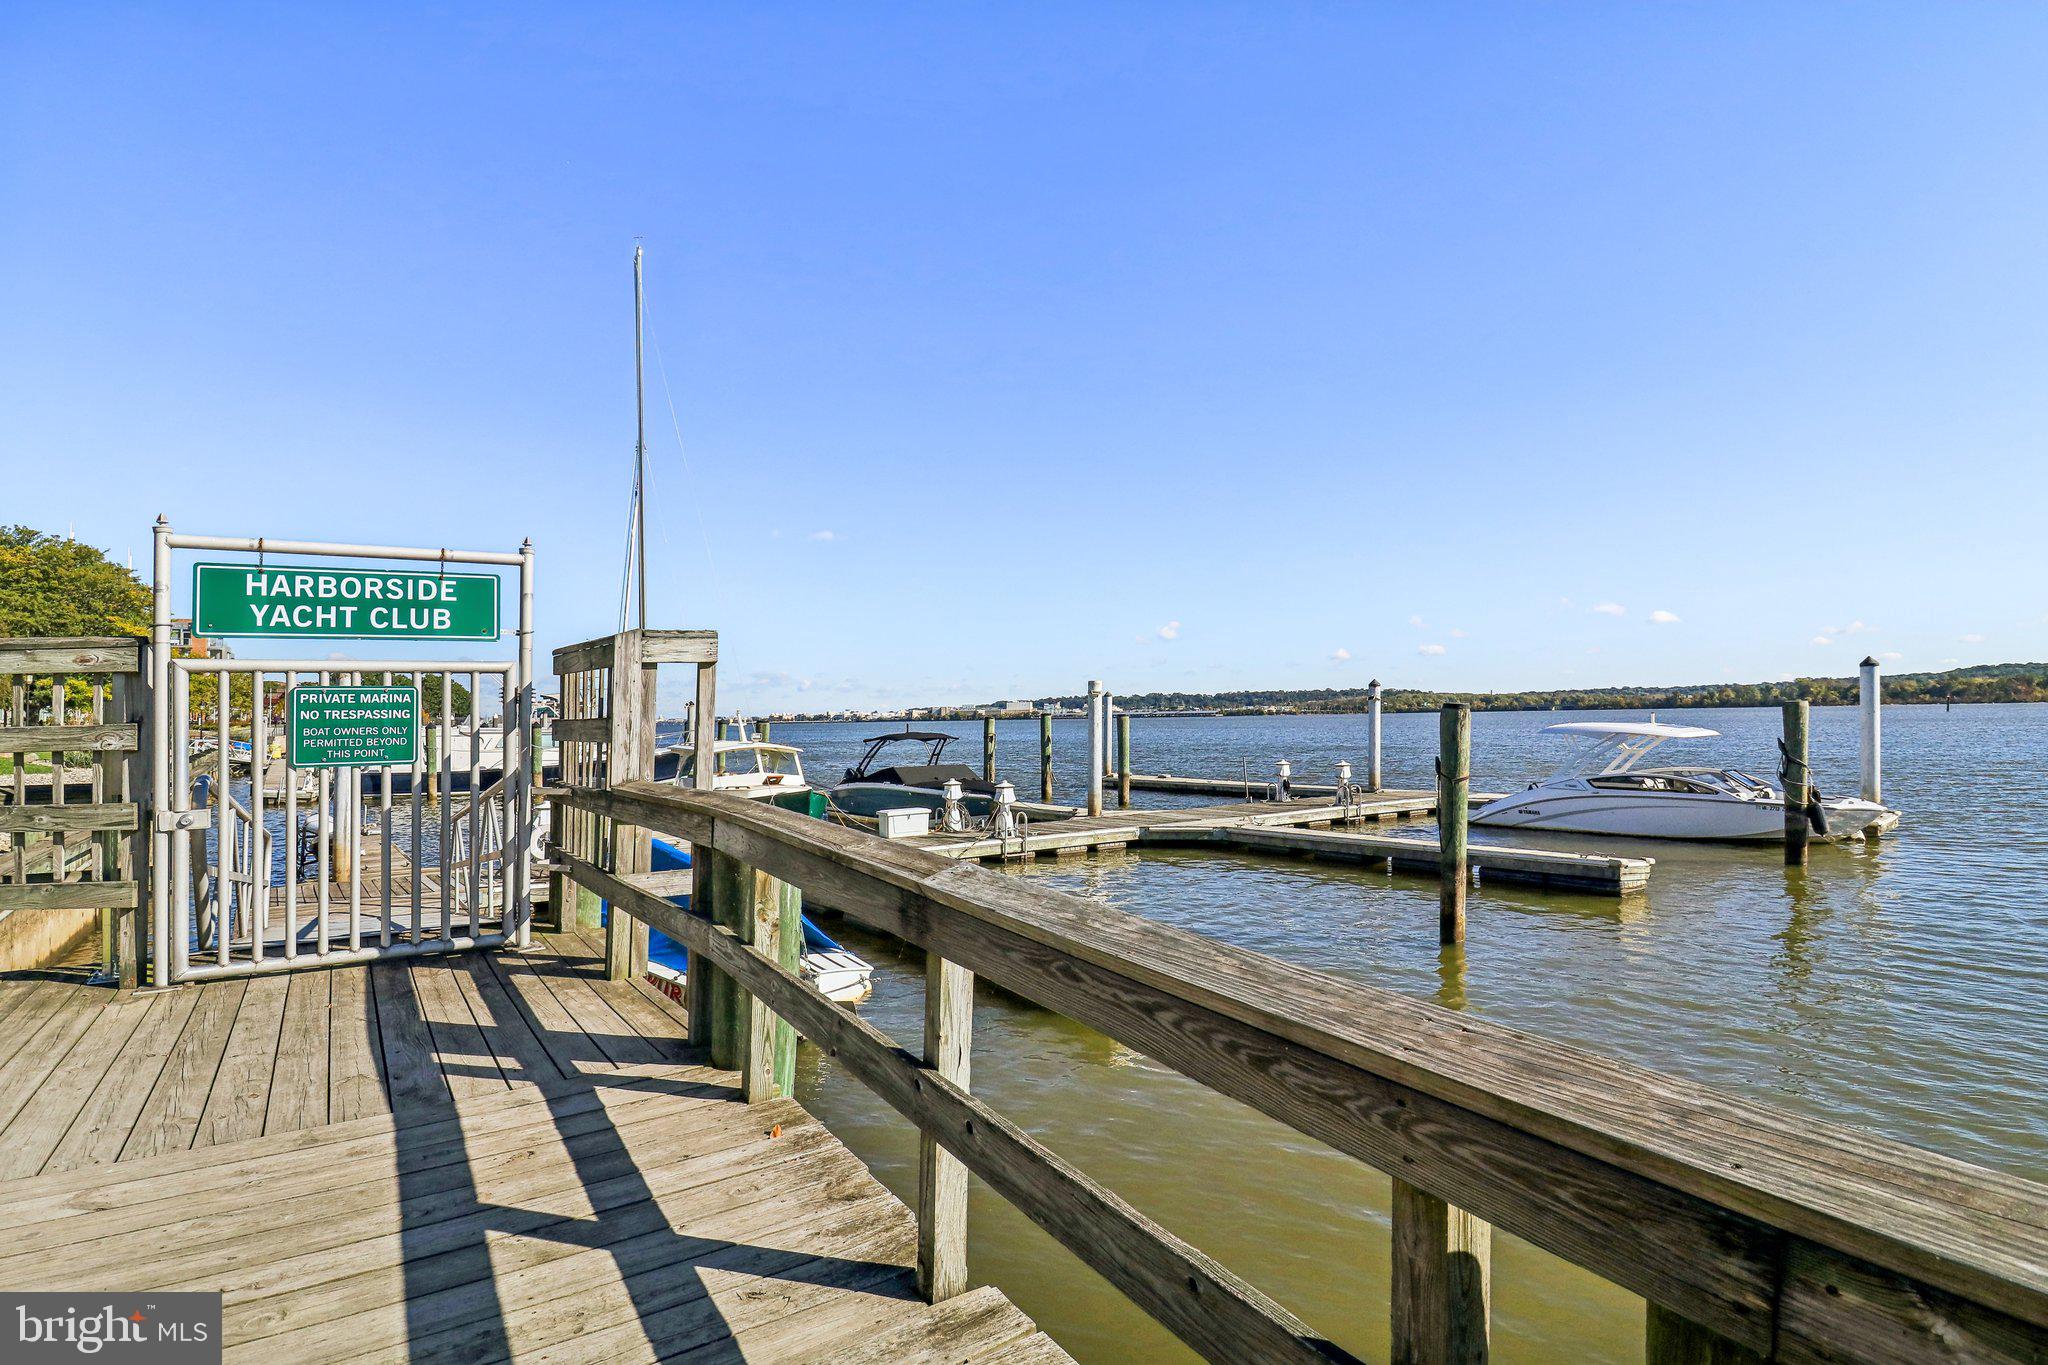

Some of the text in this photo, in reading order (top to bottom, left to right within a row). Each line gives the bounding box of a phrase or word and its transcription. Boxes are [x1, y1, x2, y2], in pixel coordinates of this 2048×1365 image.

[246, 573, 458, 602] HARBORSIDE
[249, 603, 451, 630] YACHT CLUB
[300, 693, 412, 704] PRIVATE MARINA
[300, 709, 411, 720] NO TRESPASSING
[303, 726, 408, 737] BOAT OWNERS ONLY
[303, 737, 408, 748] PERMITTED BEYOND
[327, 748, 385, 759] THIS POINT
